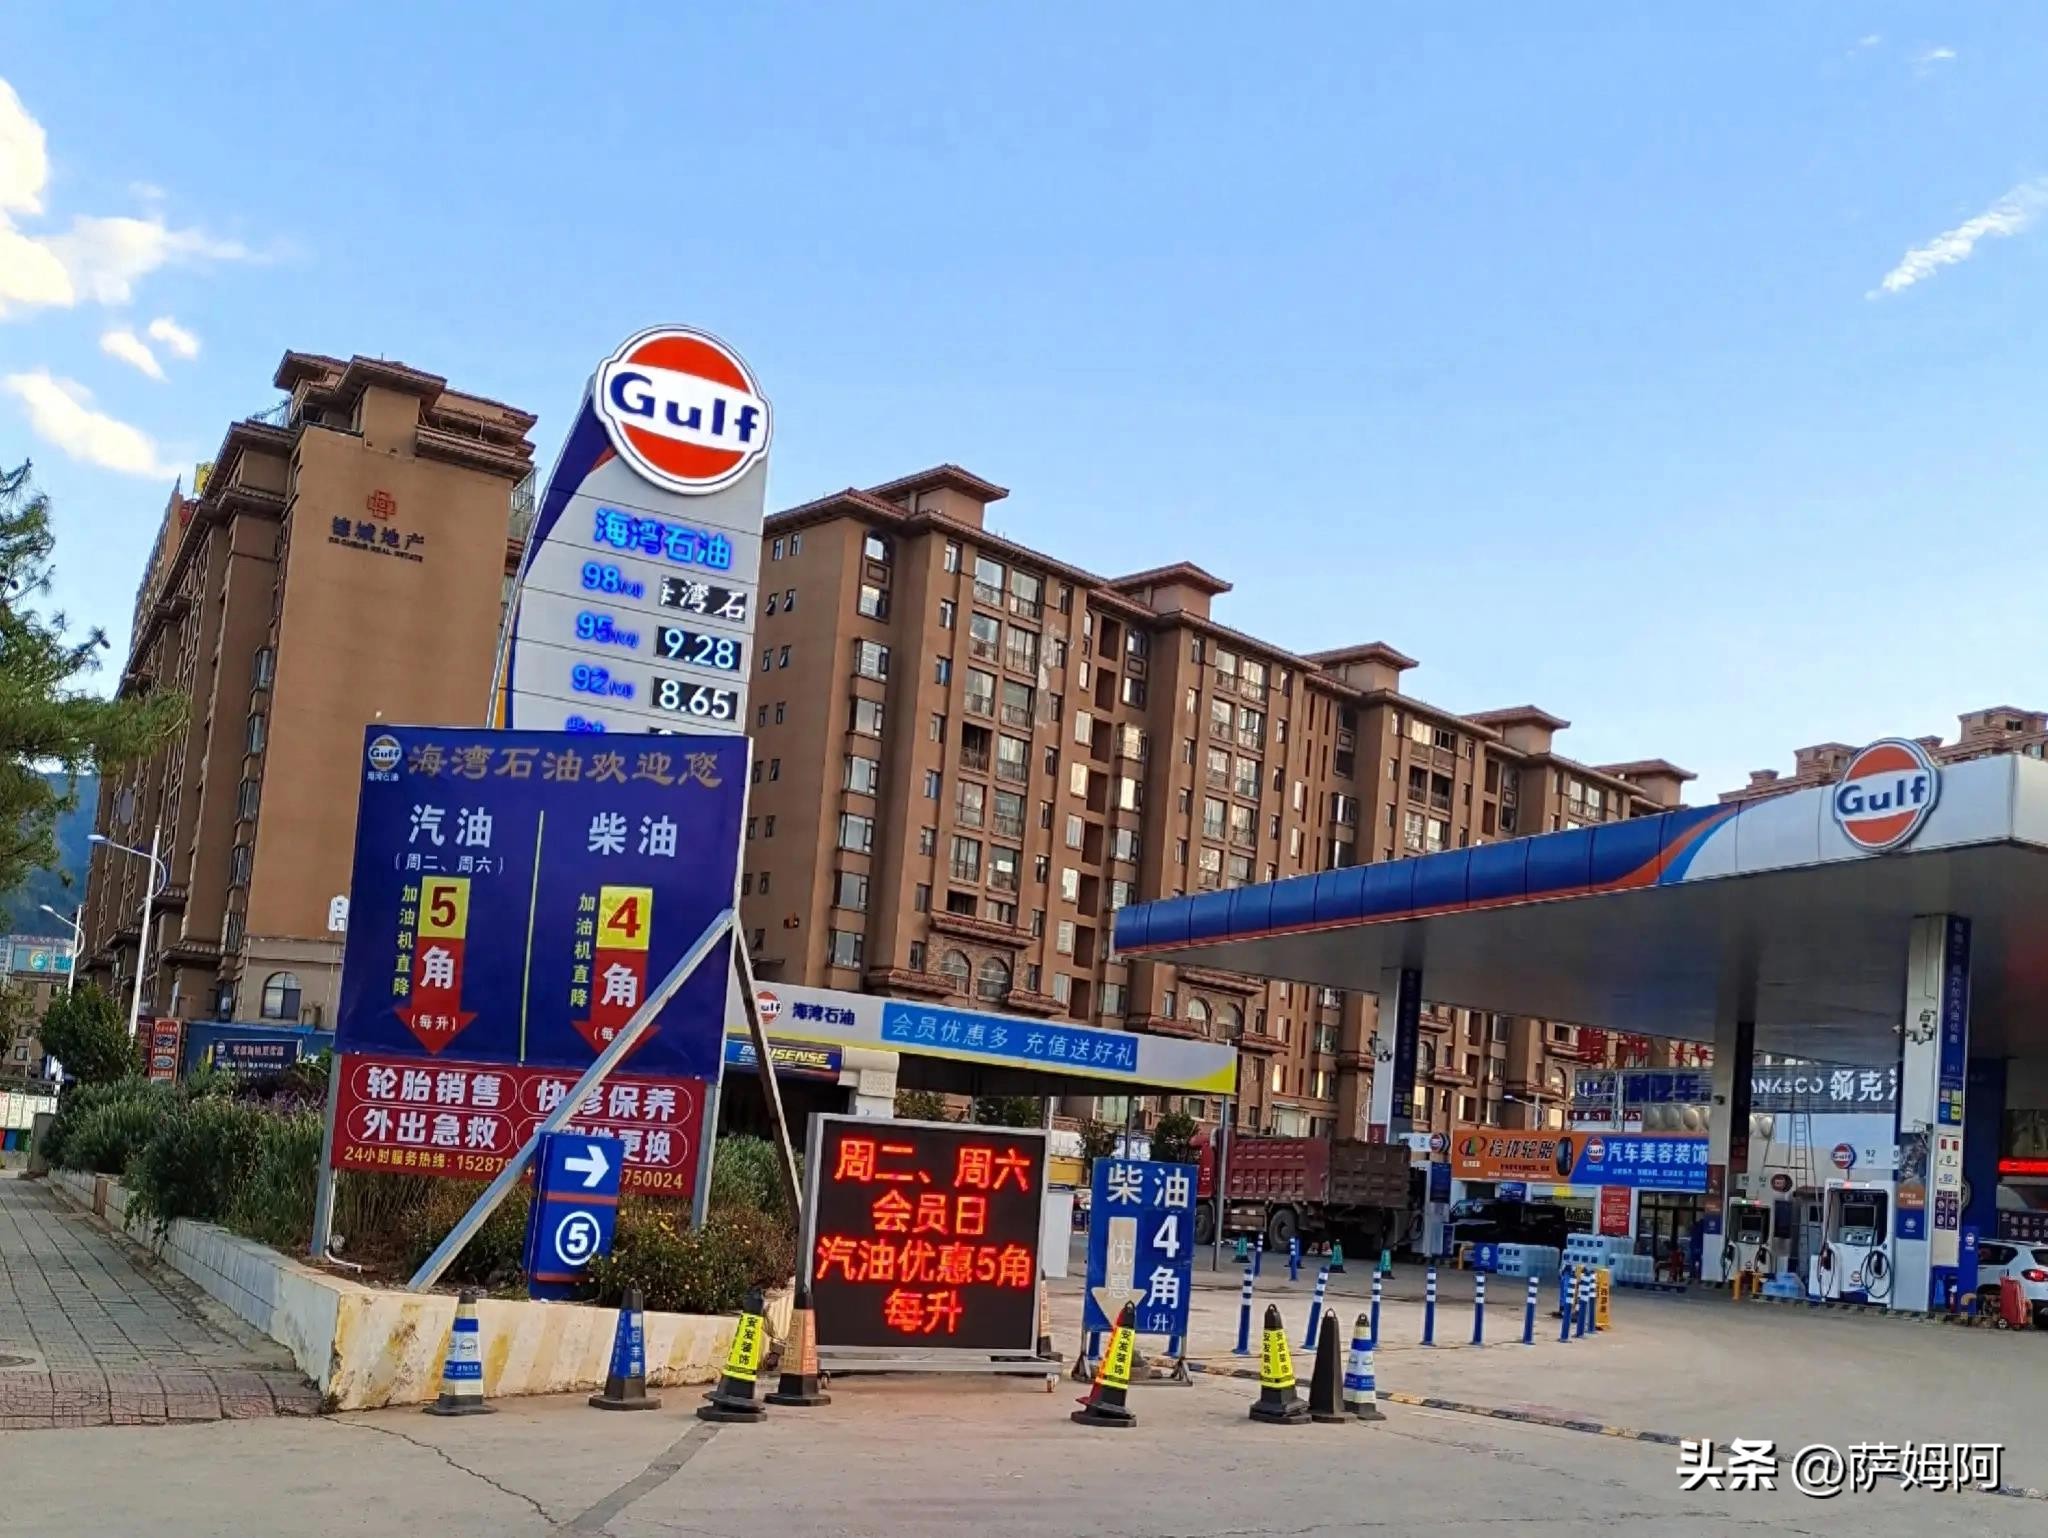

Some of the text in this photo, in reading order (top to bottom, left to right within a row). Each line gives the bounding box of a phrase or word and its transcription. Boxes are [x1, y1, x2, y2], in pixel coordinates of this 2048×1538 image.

[610, 371, 760, 442] Gulf
[592, 506, 732, 571] 海湾石油
[581, 560, 621, 594] 98
[575, 609, 615, 644] 95
[663, 627, 735, 671] 9.28
[570, 663, 610, 696] 92
[657, 678, 731, 721] 8.65
[407, 743, 723, 788] 海湾石油欢迎您
[1836, 775, 1927, 815] Gulf
[408, 803, 494, 848] 汽油
[587, 812, 679, 858] 柴油
[429, 885, 458, 928] 5
[606, 895, 642, 939] 4
[392, 884, 418, 997] 加油机直降
[570, 892, 596, 1009] 加油机直降
[419, 945, 455, 990] 角
[600, 962, 638, 1008] 角
[760, 1002, 781, 1012] ulf
[791, 1002, 856, 1026] 海湾石油
[891, 1012, 1134, 1067] 会员优惠多 充值送好礼
[366, 1065, 502, 1108] 轮胎销售
[361, 1108, 499, 1150] 外出急救
[834, 1139, 1032, 1192] 周二、周六
[1607, 1142, 1709, 1166] 汽车美容装饰
[619, 1169, 684, 1190] 750024
[1106, 1163, 1190, 1209] 柴油
[872, 1188, 986, 1236] 会员日
[816, 1235, 1031, 1288] 汽油优惠5角
[1107, 1239, 1133, 1299] 优惠
[884, 1287, 963, 1334] 每升
